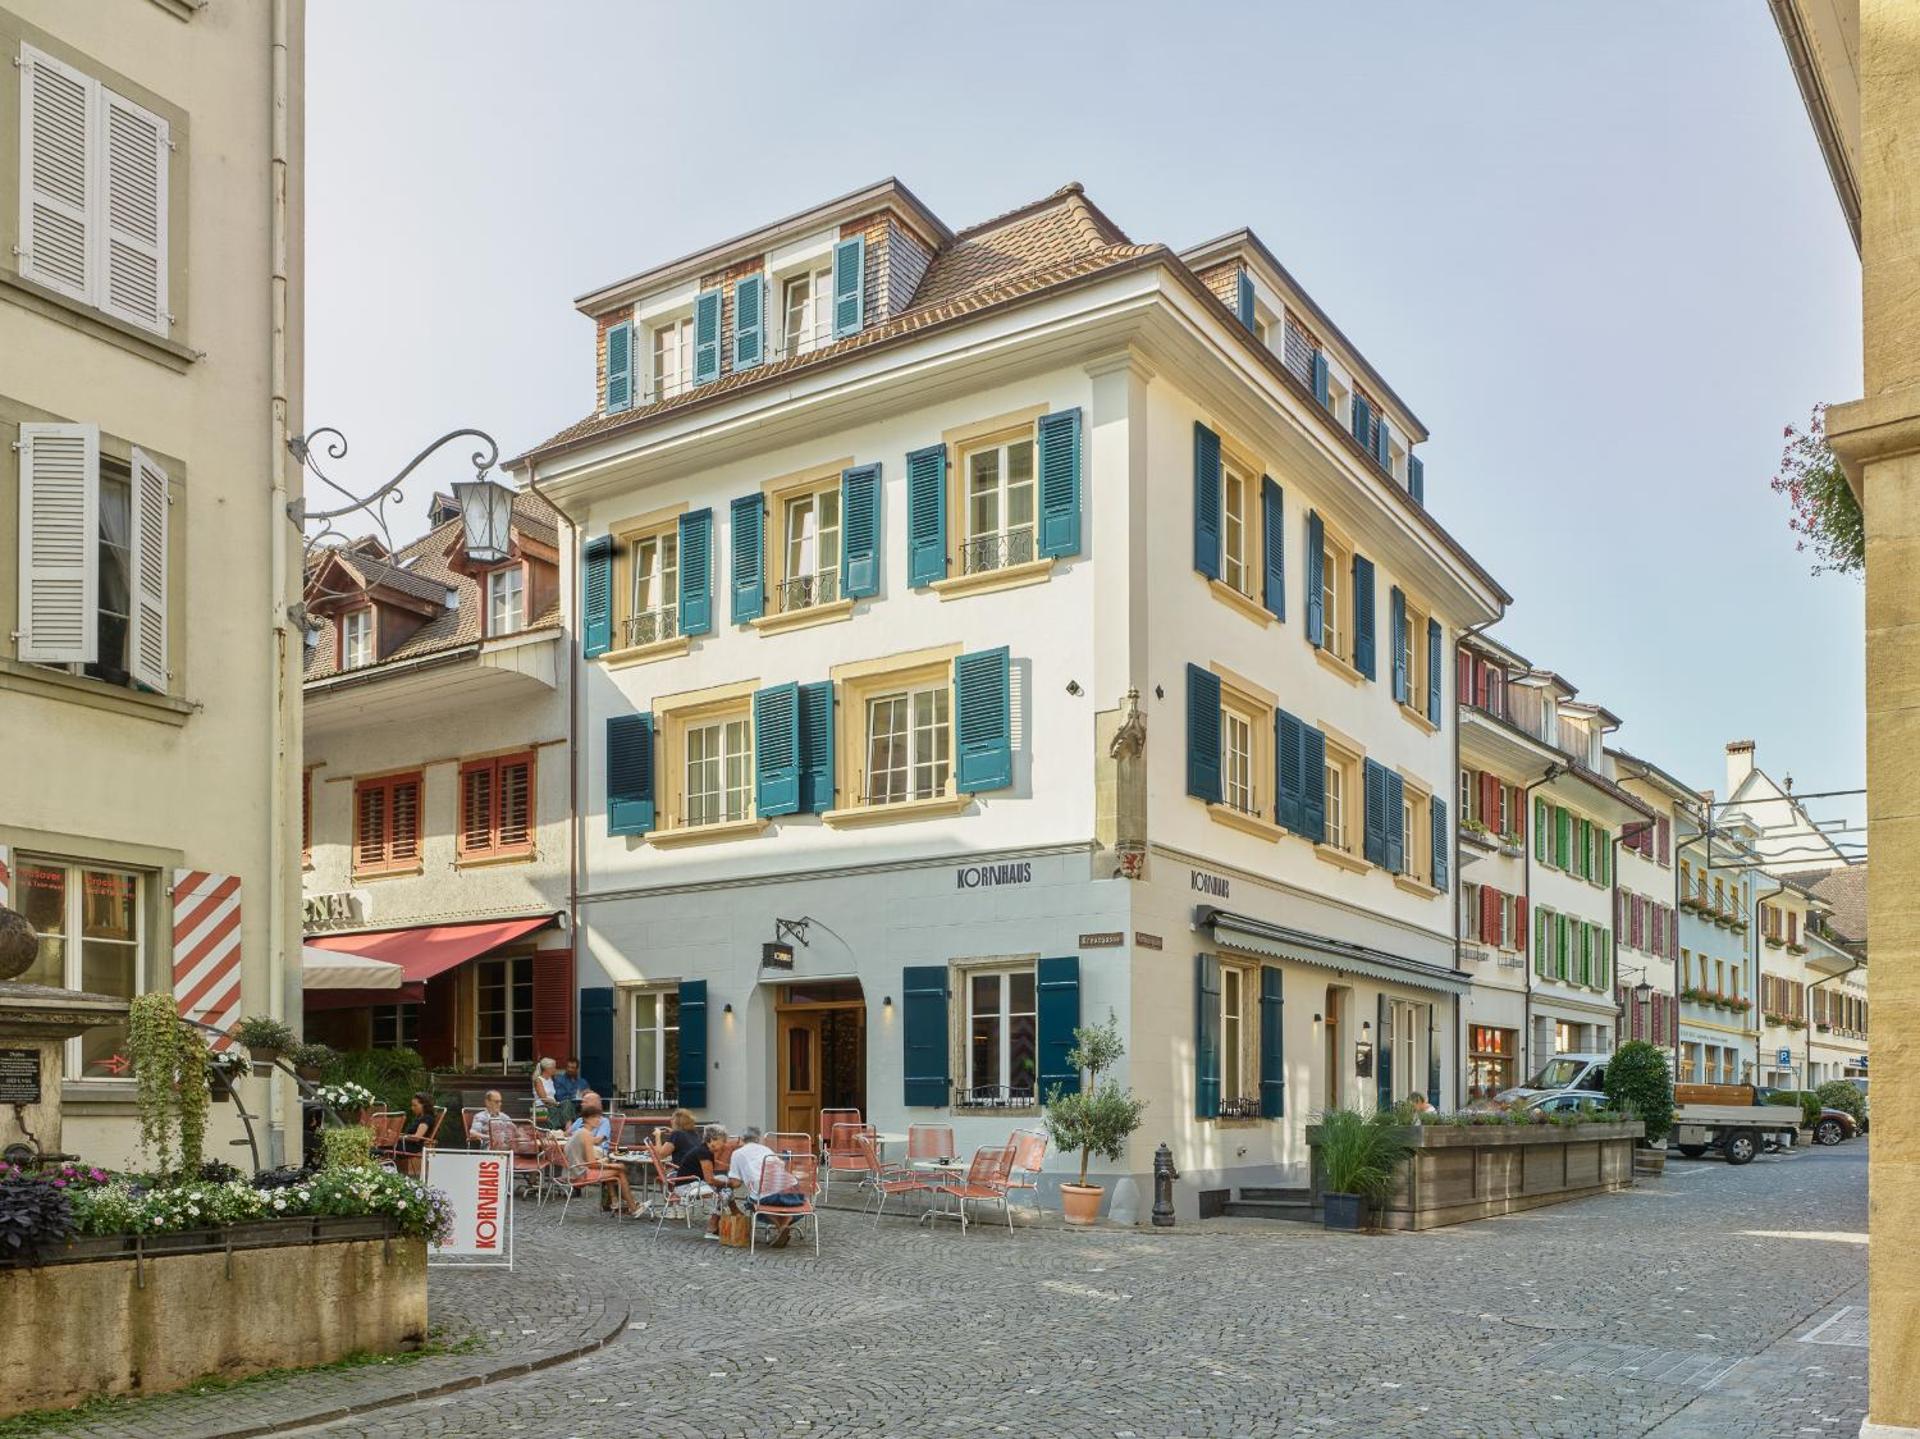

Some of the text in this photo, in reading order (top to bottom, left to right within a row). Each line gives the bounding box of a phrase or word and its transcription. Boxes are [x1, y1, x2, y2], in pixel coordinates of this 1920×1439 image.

[957, 862, 1031, 889] KORNHAUS
[1191, 870, 1230, 898] KORNHAUS
[476, 1161, 499, 1249] KORNHAUS
